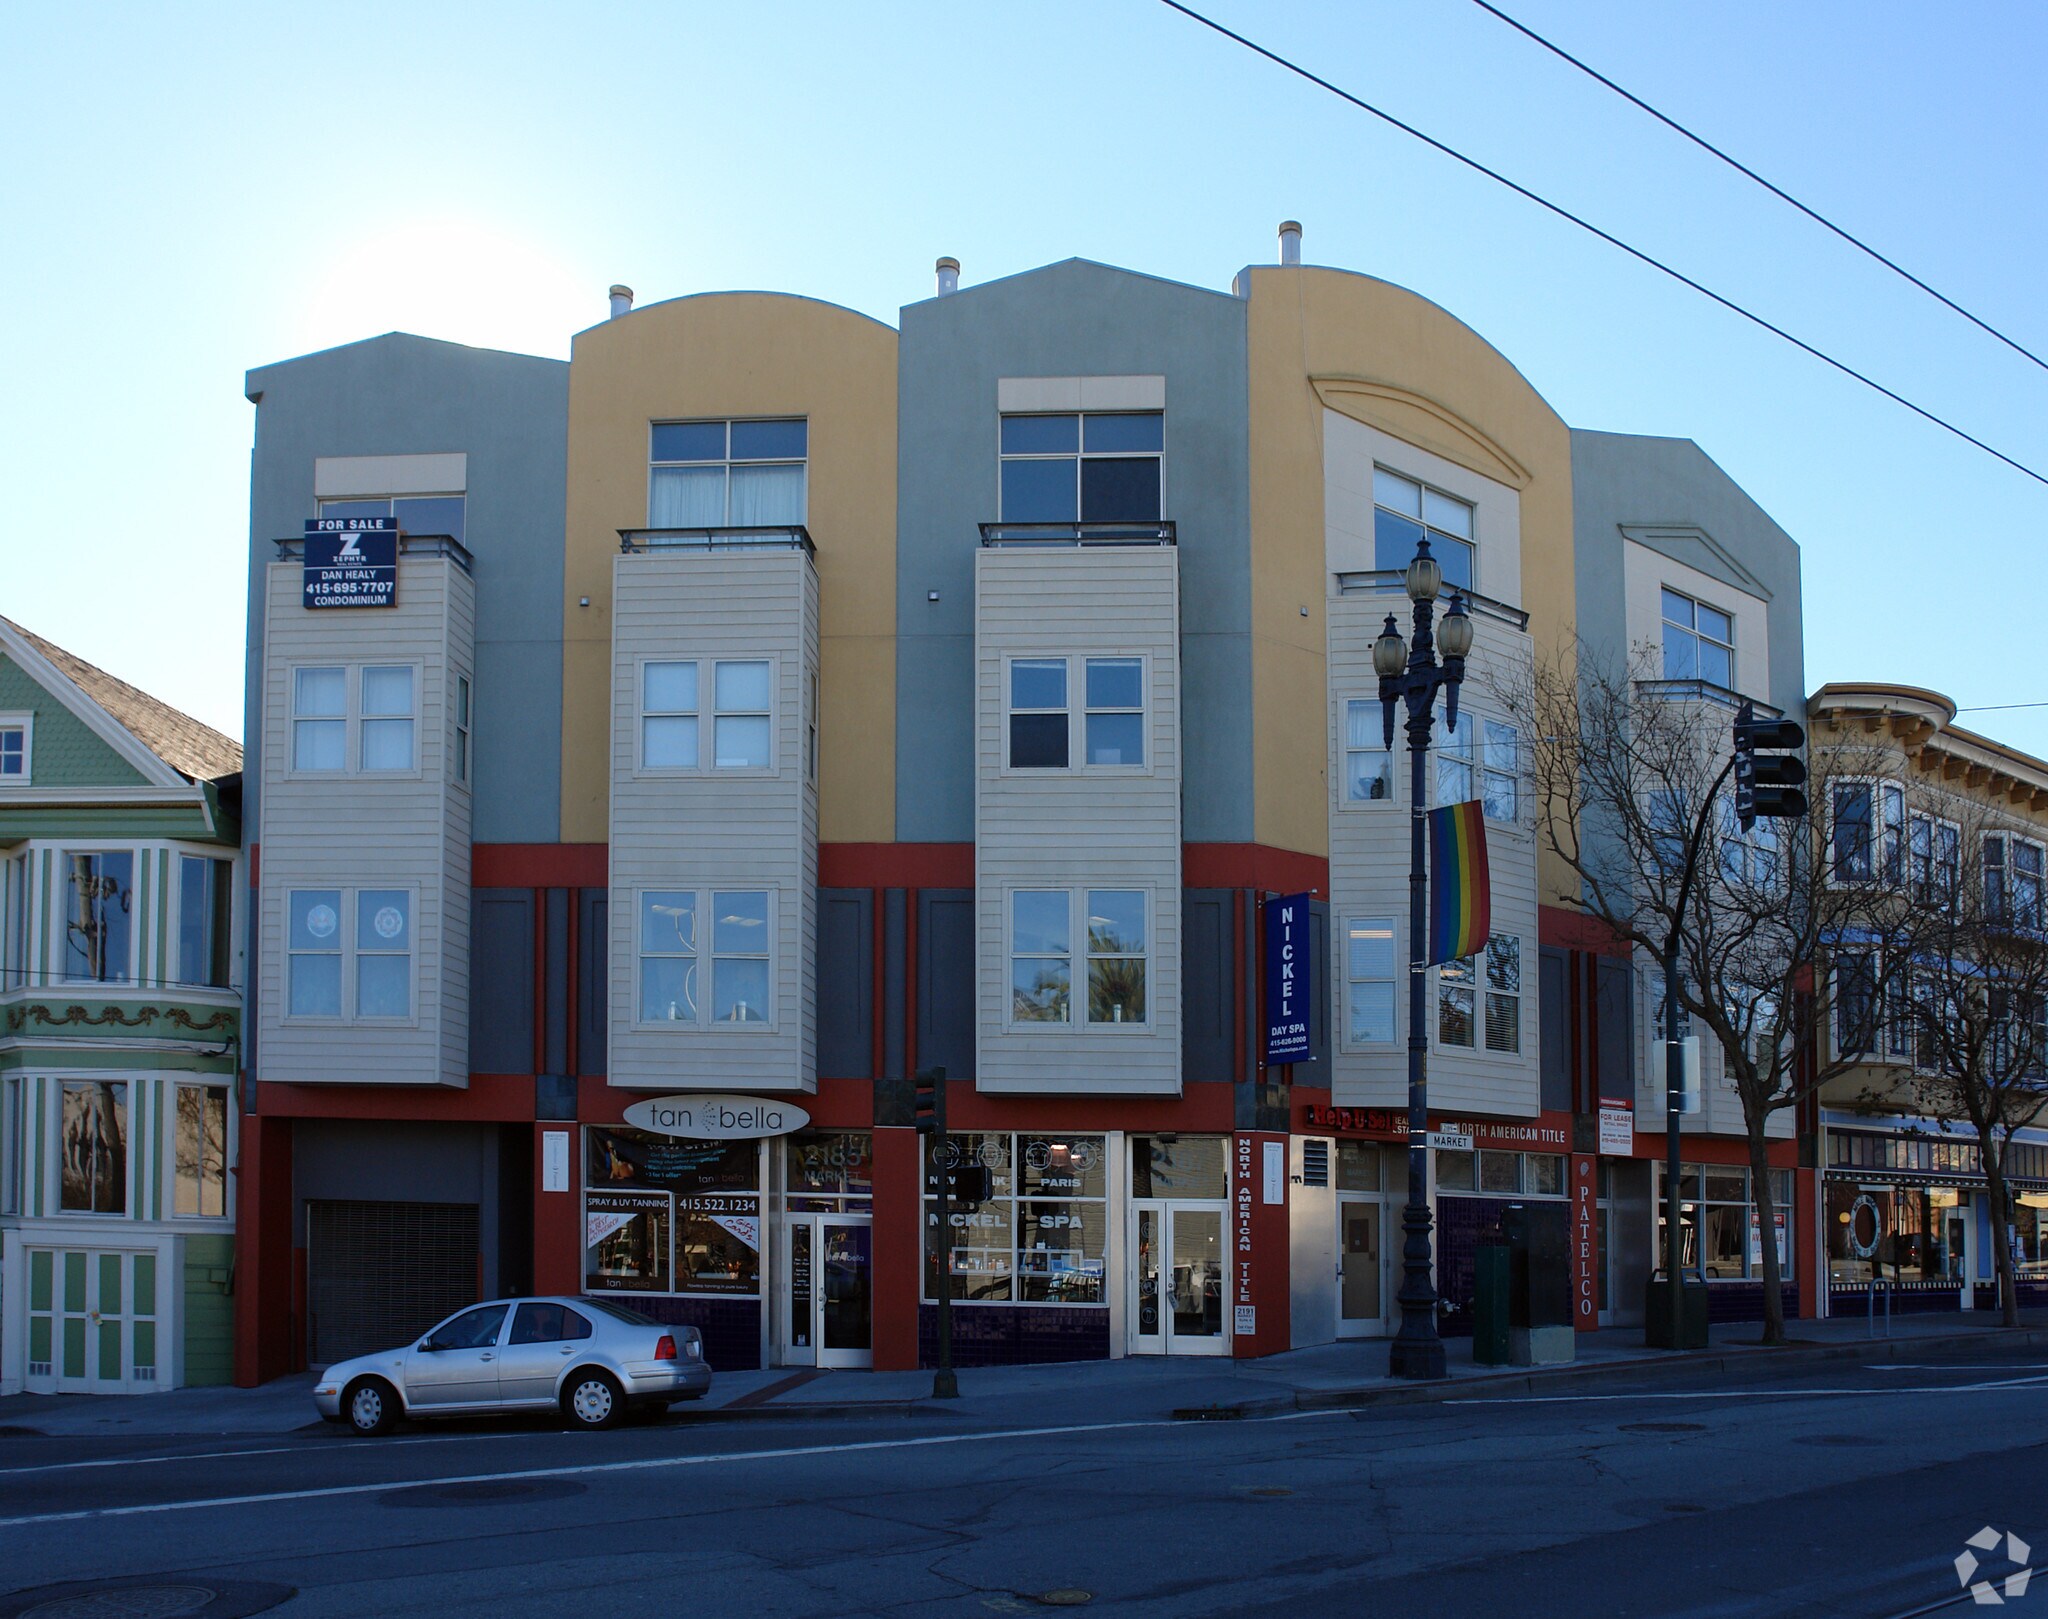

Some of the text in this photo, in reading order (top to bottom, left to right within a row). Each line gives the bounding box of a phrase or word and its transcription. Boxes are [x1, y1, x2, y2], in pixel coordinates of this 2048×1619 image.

[318, 519, 384, 530] FOR SALE
[339, 533, 361, 556] Z
[332, 555, 367, 563] ZEPHYR
[321, 570, 376, 580] DAN HEALY
[314, 595, 387, 606] CONDOMINIUM
[1281, 906, 1295, 1017] NICKEL
[1271, 1023, 1306, 1037] DAY SPA
[650, 1104, 783, 1130] tan bella
[1614, 1114, 1631, 1122] LEASE
[1490, 1126, 1538, 1141] AMERICAN
[1540, 1129, 1565, 1143] TITLE
[1433, 1136, 1467, 1147] MARKET
[805, 1144, 862, 1167] 2185
[698, 1173, 745, 1184] tan bella
[804, 1170, 861, 1183] MARKET
[929, 1175, 957, 1186] NW
[1039, 1178, 1082, 1188] PARIS
[587, 1197, 669, 1209] SPRAY & UV TANNING
[679, 1198, 757, 1212] 415.522.1234
[736, 1218, 756, 1233] Gift
[929, 1213, 1084, 1229] NCKEL SPA
[1238, 1138, 1252, 1302] NORTH AMERICAN TITLE
[724, 1219, 756, 1244] Cards
[1580, 1186, 1592, 1316] PATELCO
[606, 1279, 651, 1289] tan bella
